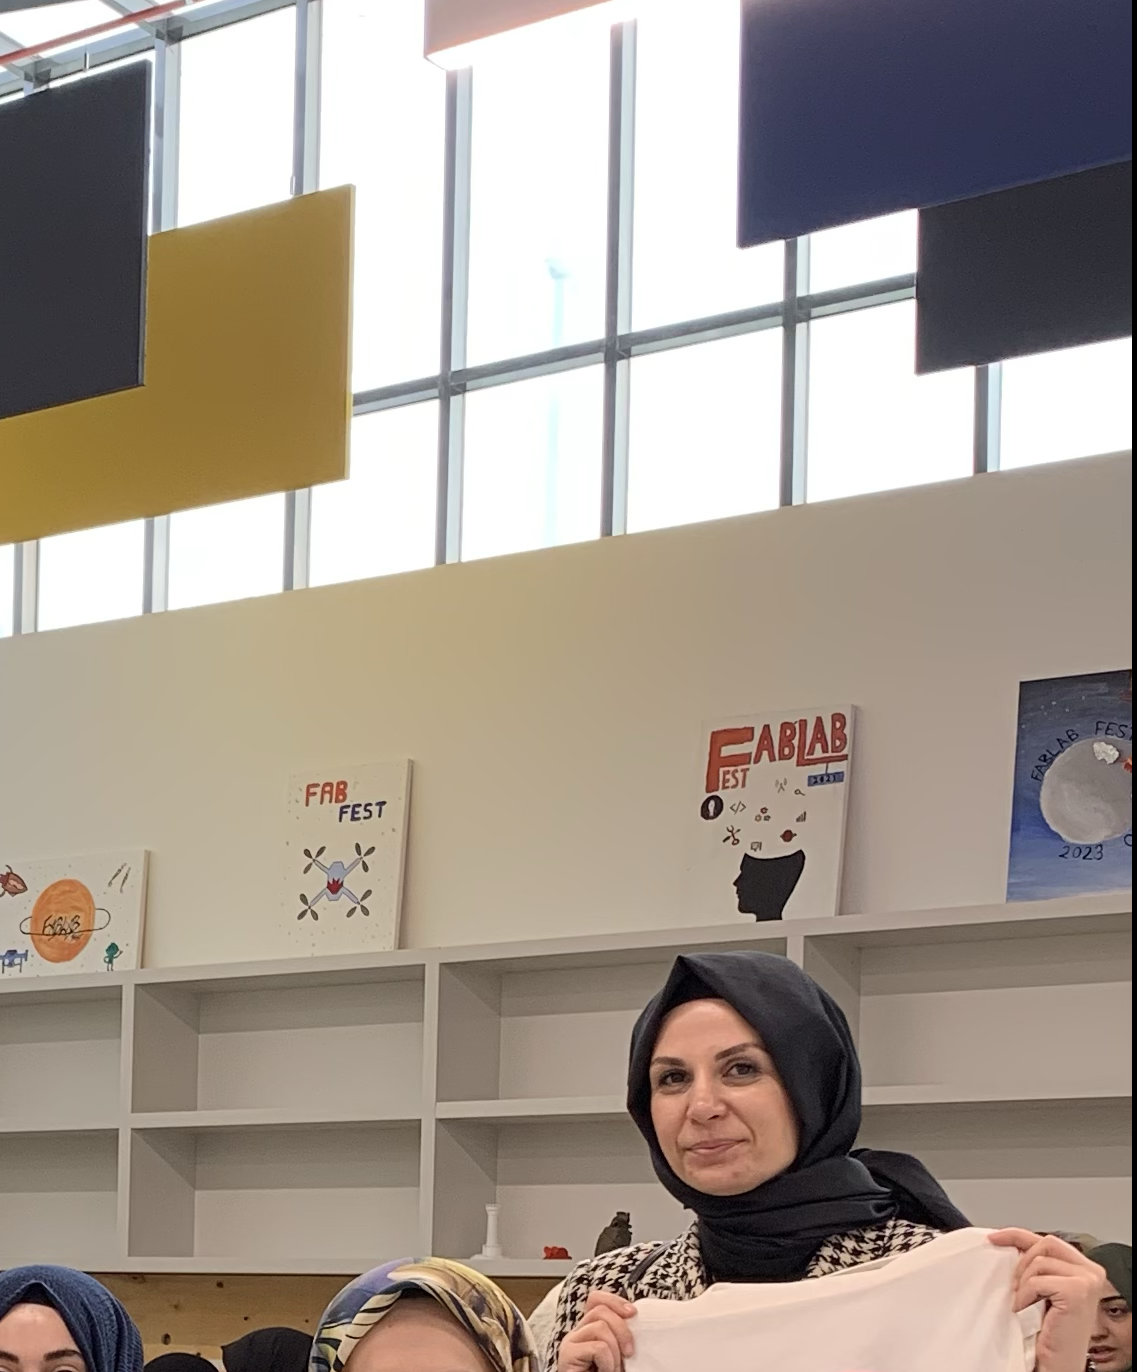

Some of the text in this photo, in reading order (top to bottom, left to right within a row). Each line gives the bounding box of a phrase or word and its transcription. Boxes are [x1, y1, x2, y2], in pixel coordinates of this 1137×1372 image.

[706, 713, 848, 793] FABLAB
[1030, 720, 1132, 782] FABLAB FES
[305, 781, 348, 807] FAB
[338, 801, 387, 822] FEST
[1058, 844, 1104, 860] 2023
